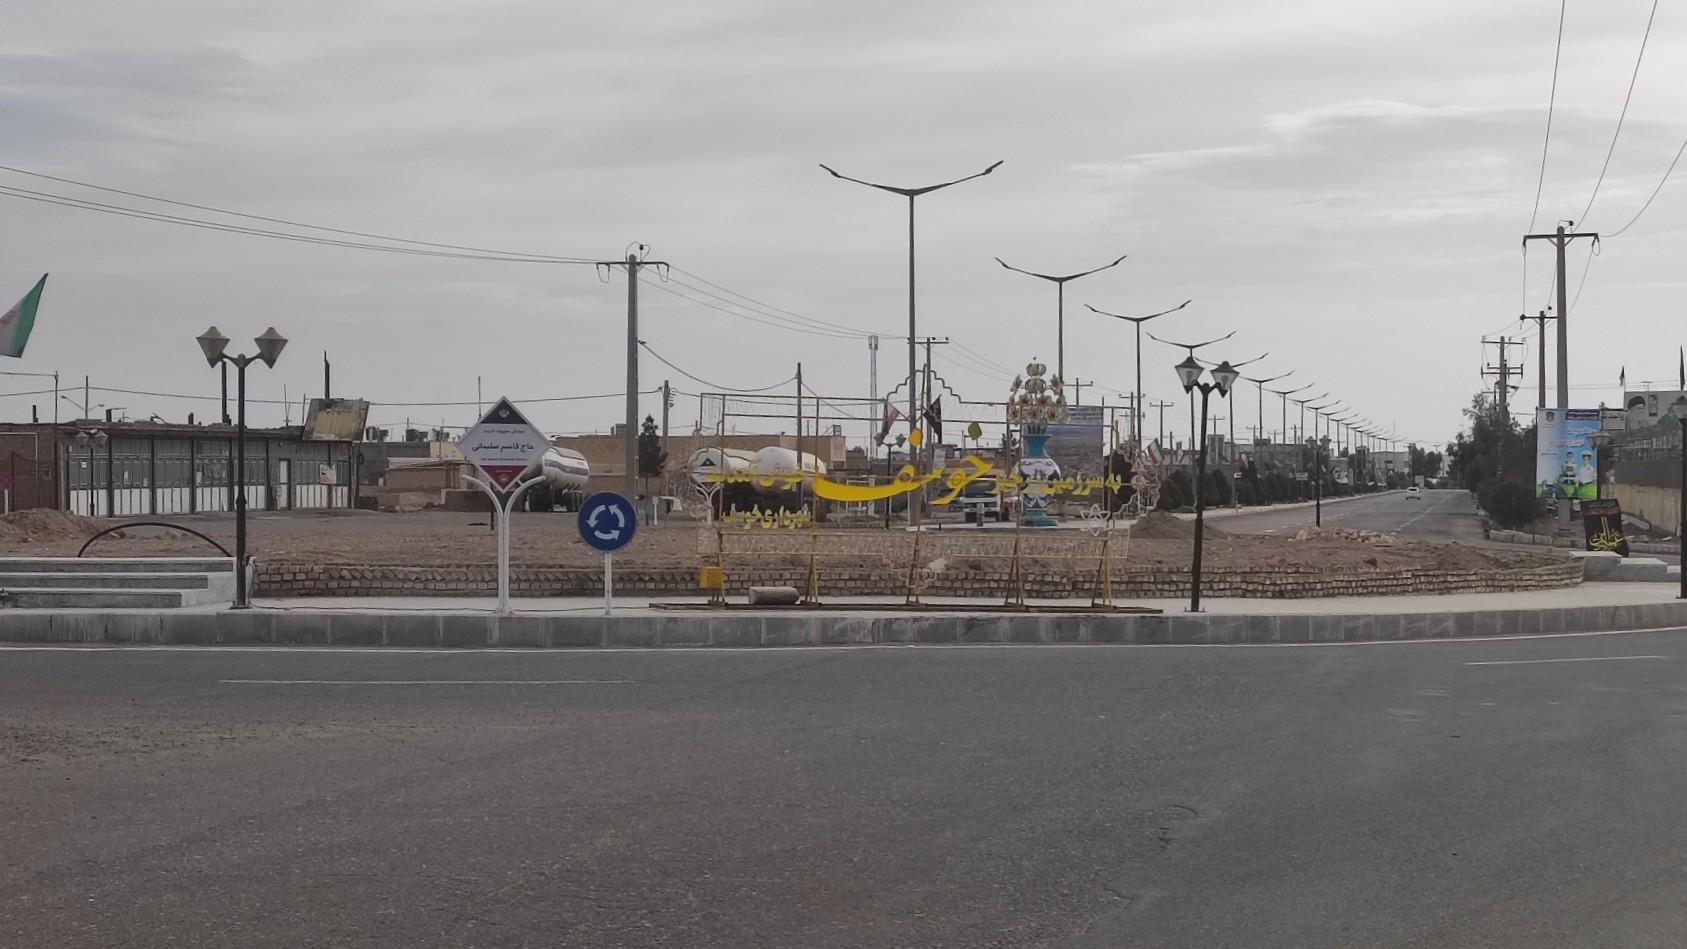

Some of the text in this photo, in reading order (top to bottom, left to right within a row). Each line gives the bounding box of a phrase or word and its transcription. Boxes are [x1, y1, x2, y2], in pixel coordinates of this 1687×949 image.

[471, 441, 535, 454] حاج قاسم سلیمانی
